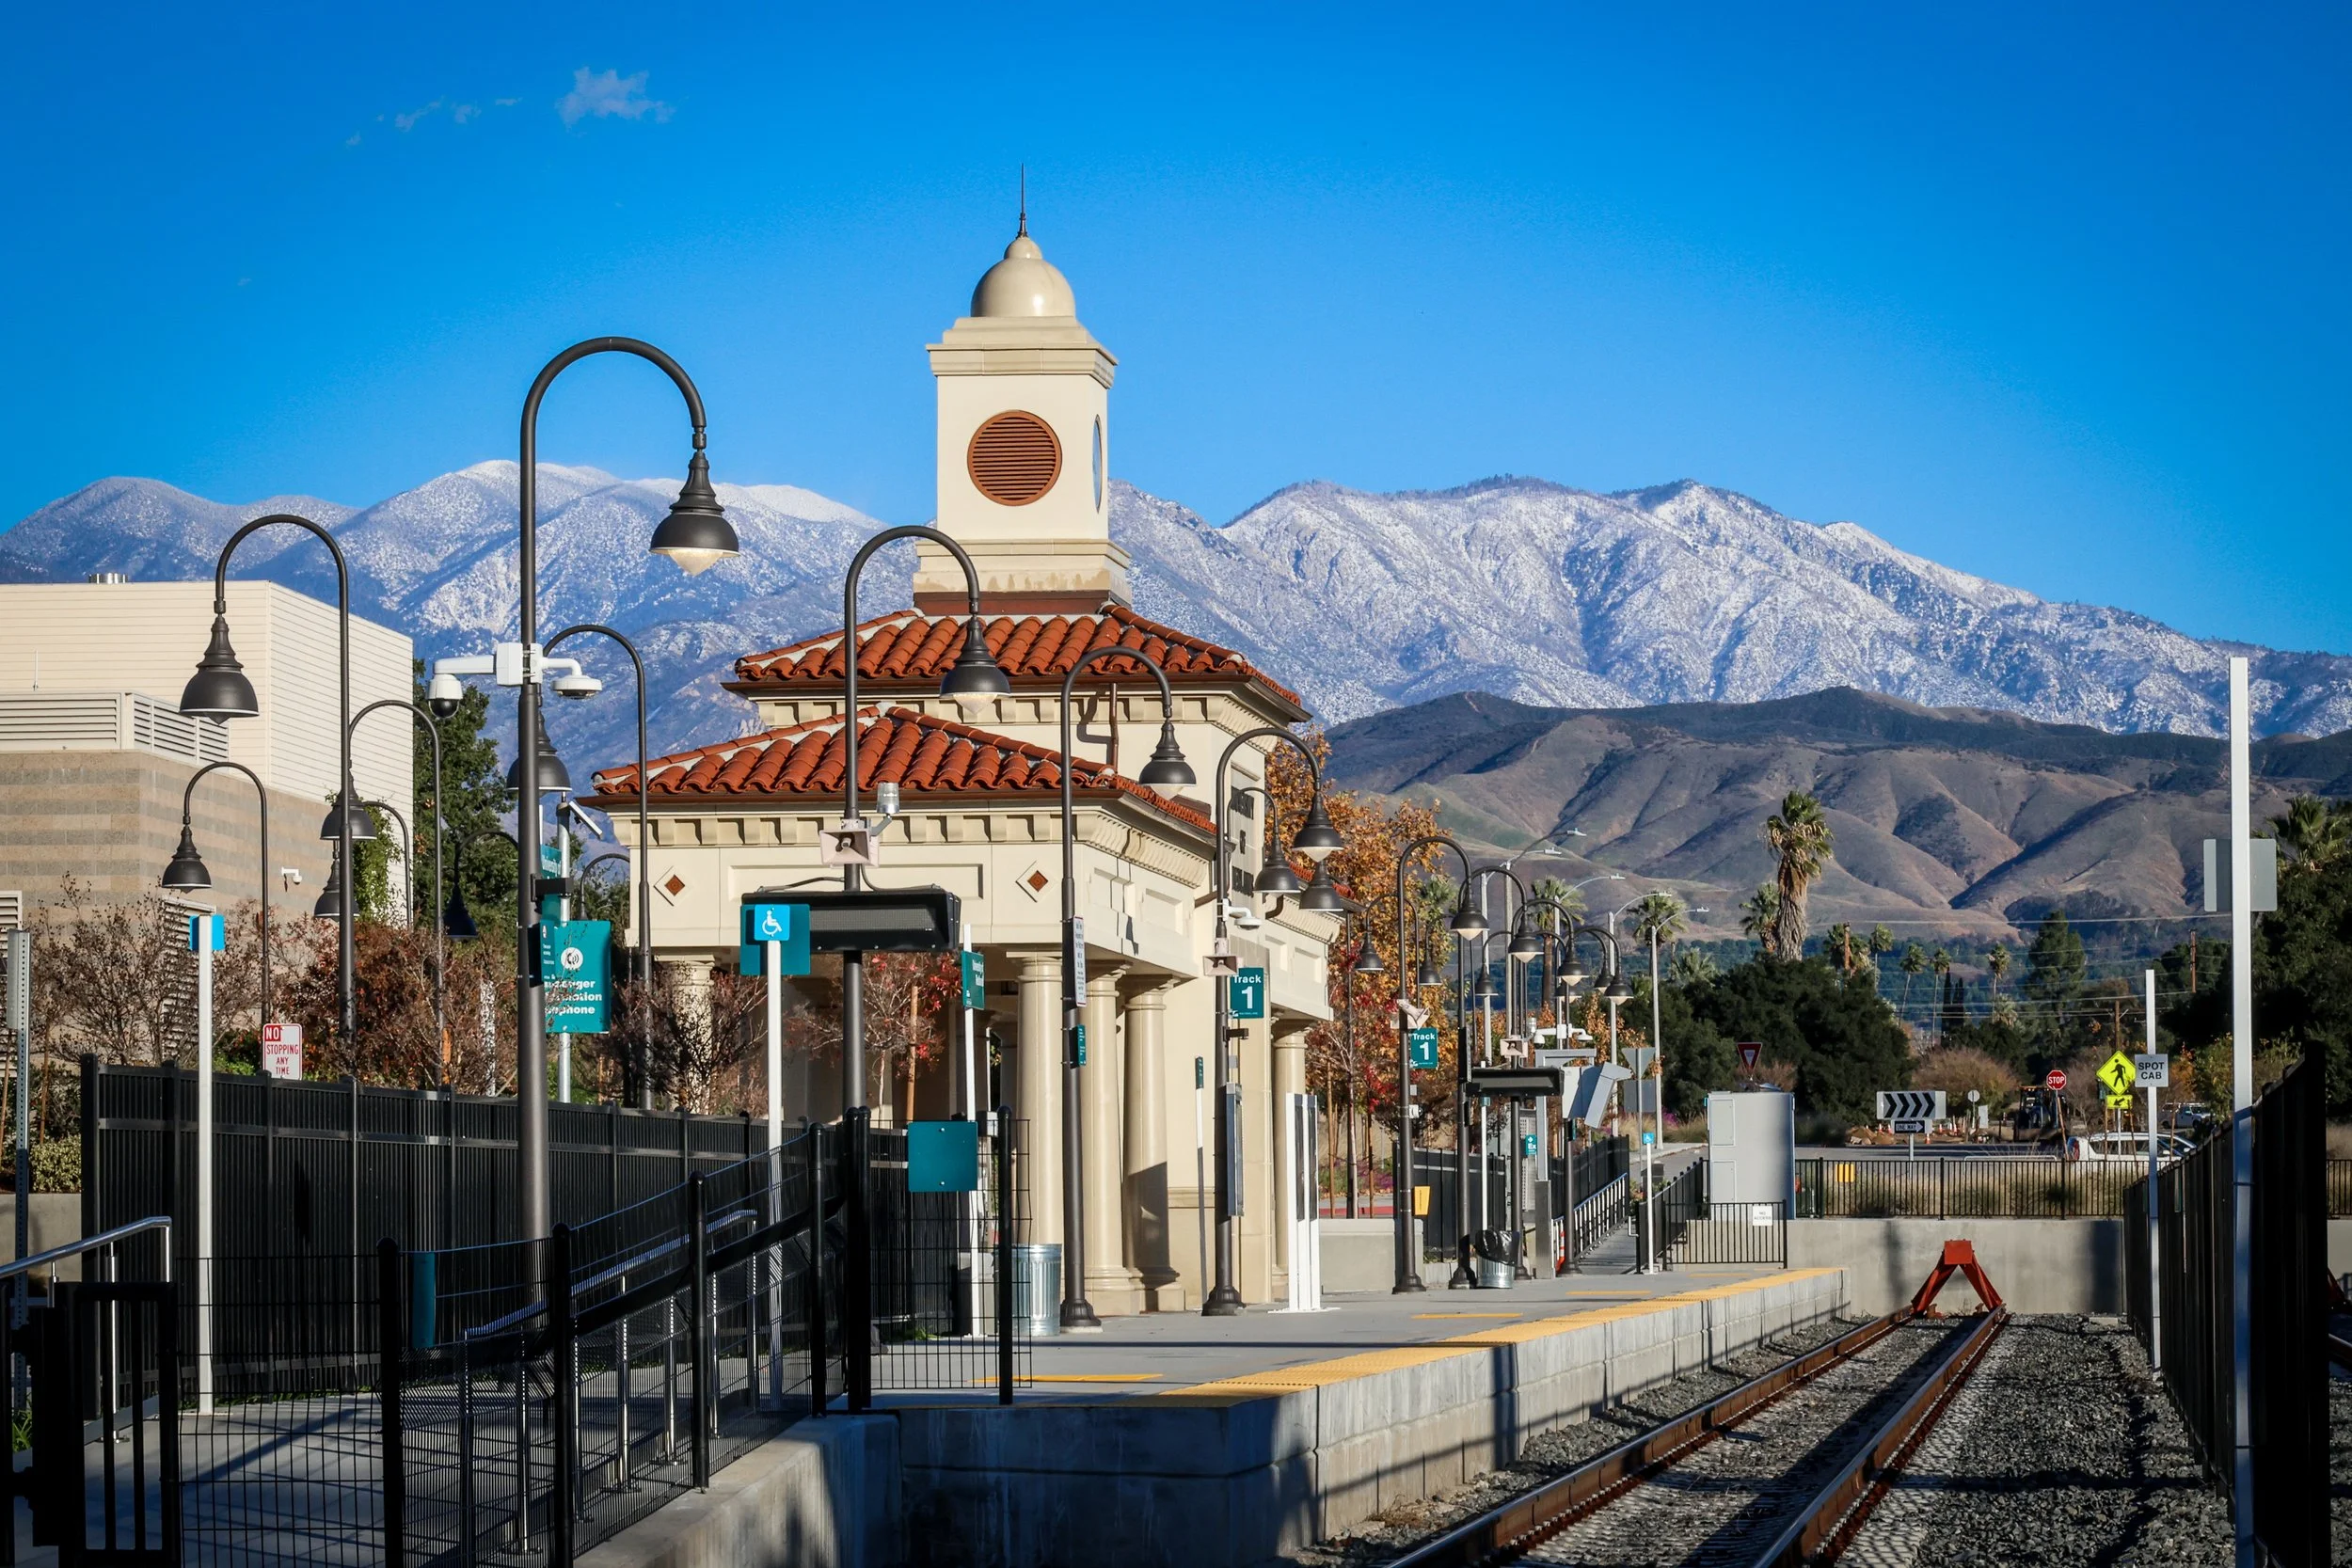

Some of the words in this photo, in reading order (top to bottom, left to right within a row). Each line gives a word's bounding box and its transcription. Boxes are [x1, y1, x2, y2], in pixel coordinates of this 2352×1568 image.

[1233, 974, 1262, 984] Track
[1241, 986, 1253, 1009] 1
[265, 1026, 279, 1040] NO
[266, 1044, 299, 1055] STOPPING
[1419, 1041, 1429, 1061] 1
[276, 1056, 289, 1065] ANY
[2137, 1061, 2165, 1070] SPOT
[276, 1067, 290, 1075] TIME
[2140, 1071, 2162, 1080] CAB
[2048, 1076, 2065, 1085] STOP
